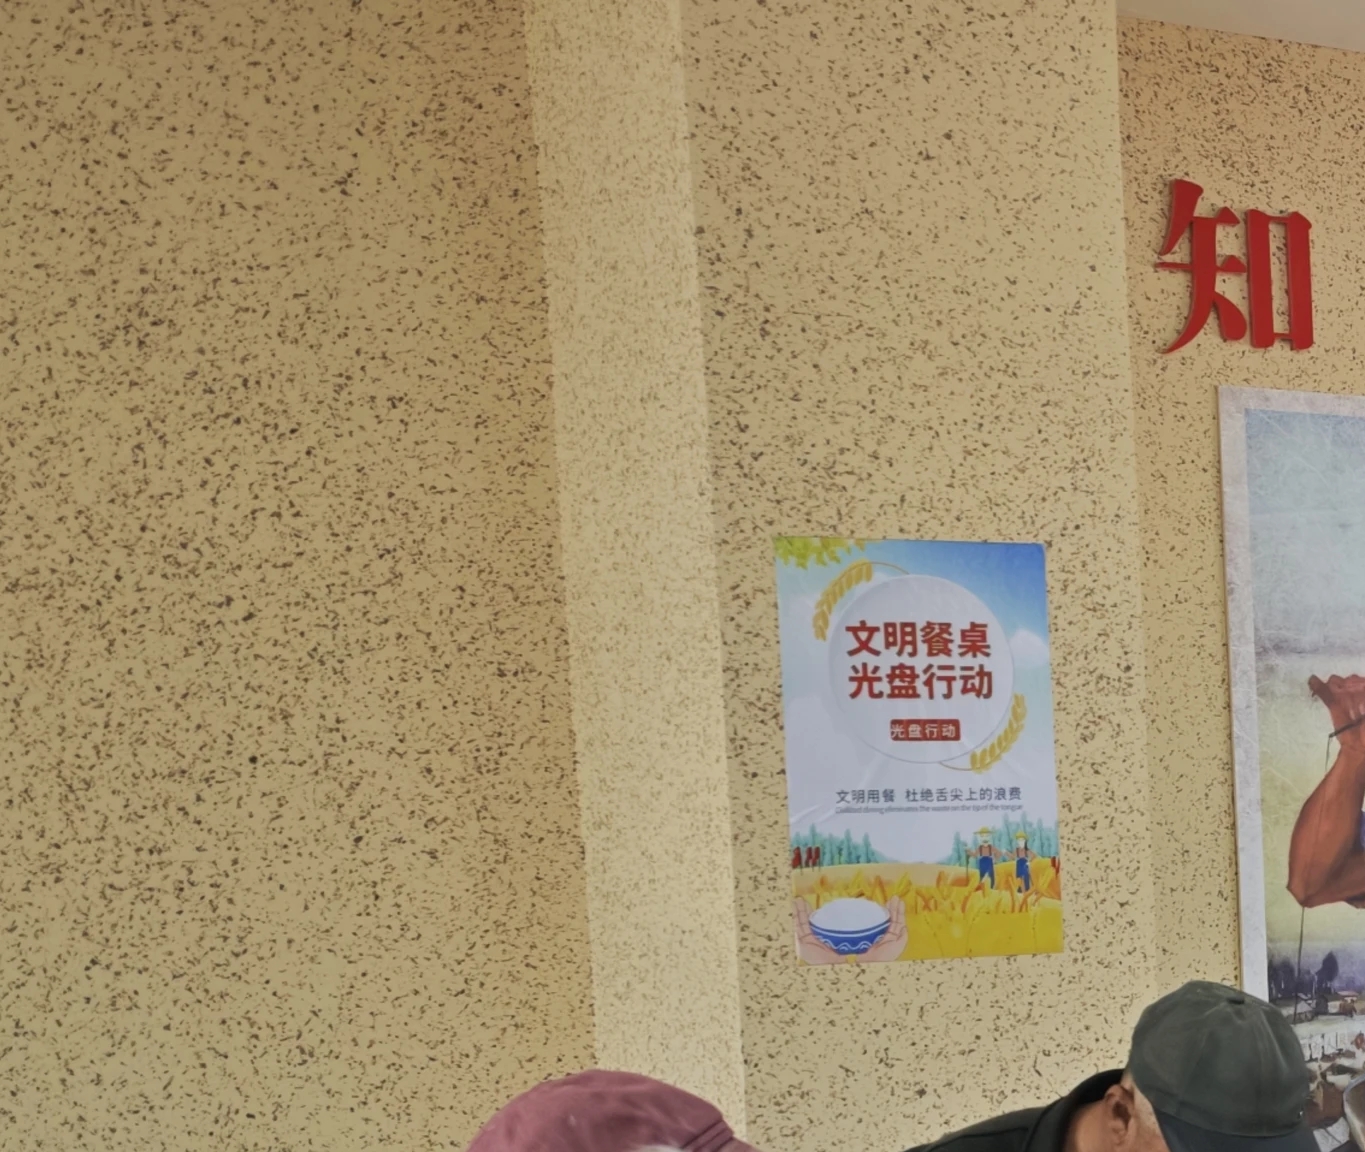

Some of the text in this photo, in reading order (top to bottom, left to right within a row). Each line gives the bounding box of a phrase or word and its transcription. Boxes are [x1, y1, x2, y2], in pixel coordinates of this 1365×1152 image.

[845, 620, 991, 658] 文明餐桌
[848, 662, 993, 700] 光盘行动
[891, 723, 956, 739] 光盘行动
[835, 786, 1022, 804] 文明用餐 杜绝舌尖上的浪费
